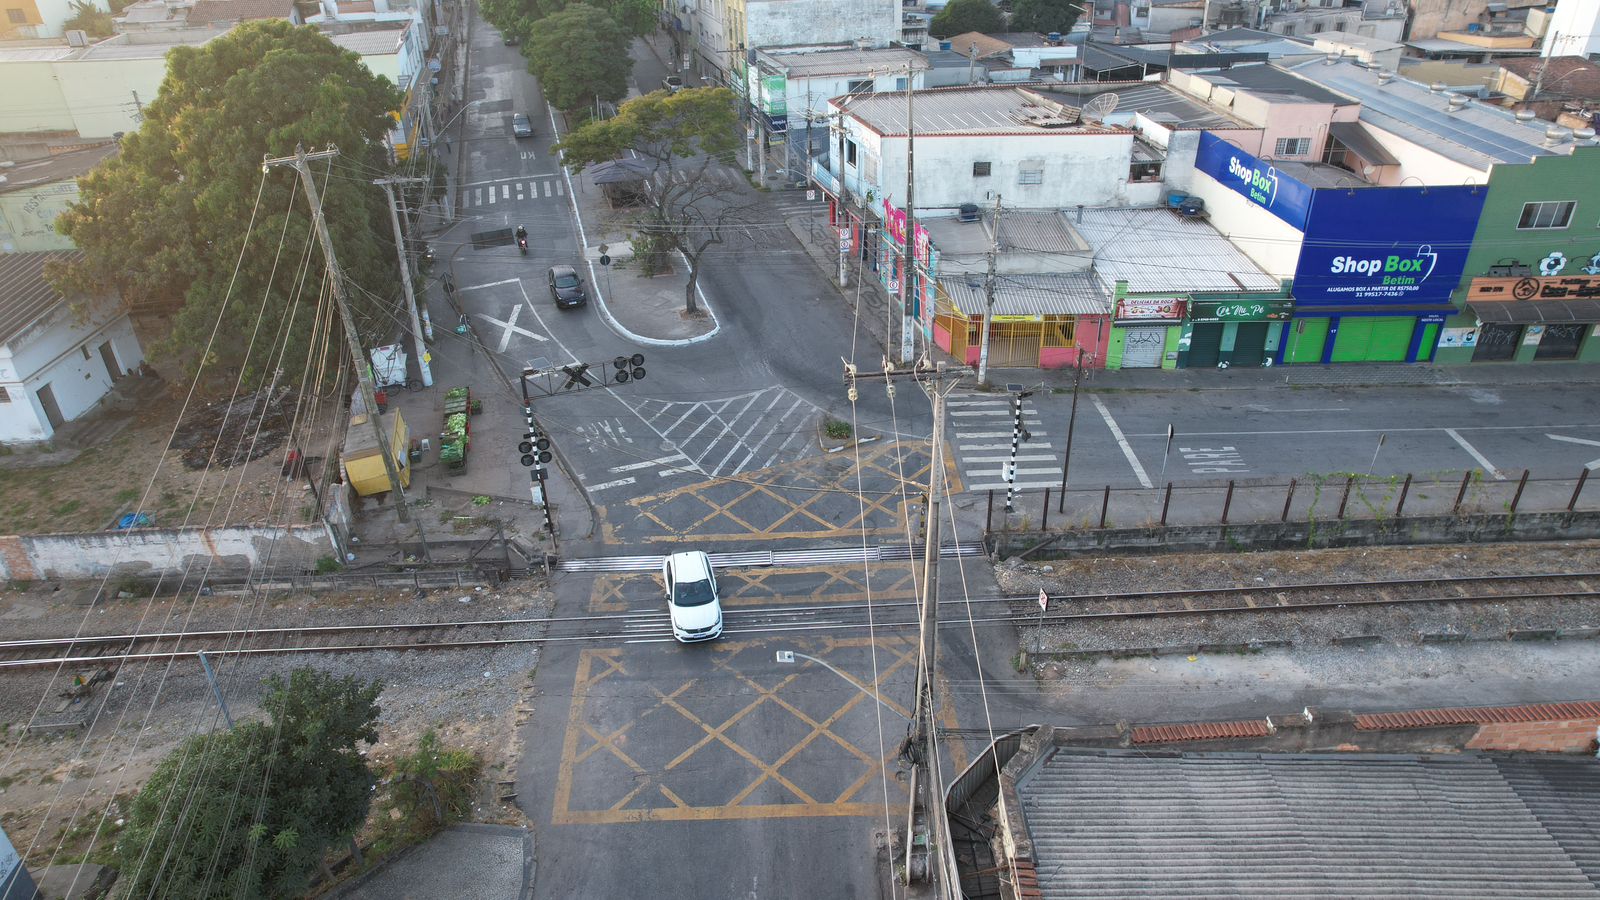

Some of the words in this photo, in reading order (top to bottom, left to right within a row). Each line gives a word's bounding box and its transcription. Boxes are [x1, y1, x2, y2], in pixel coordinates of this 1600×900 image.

[1229, 156, 1252, 186] Shop
[1252, 168, 1271, 194] Box
[1250, 187, 1266, 204] Betim
[1330, 256, 1382, 277] Shop
[1384, 255, 1424, 272] Box
[1382, 275, 1415, 285] Betim
[1179, 446, 1250, 473] PARE
